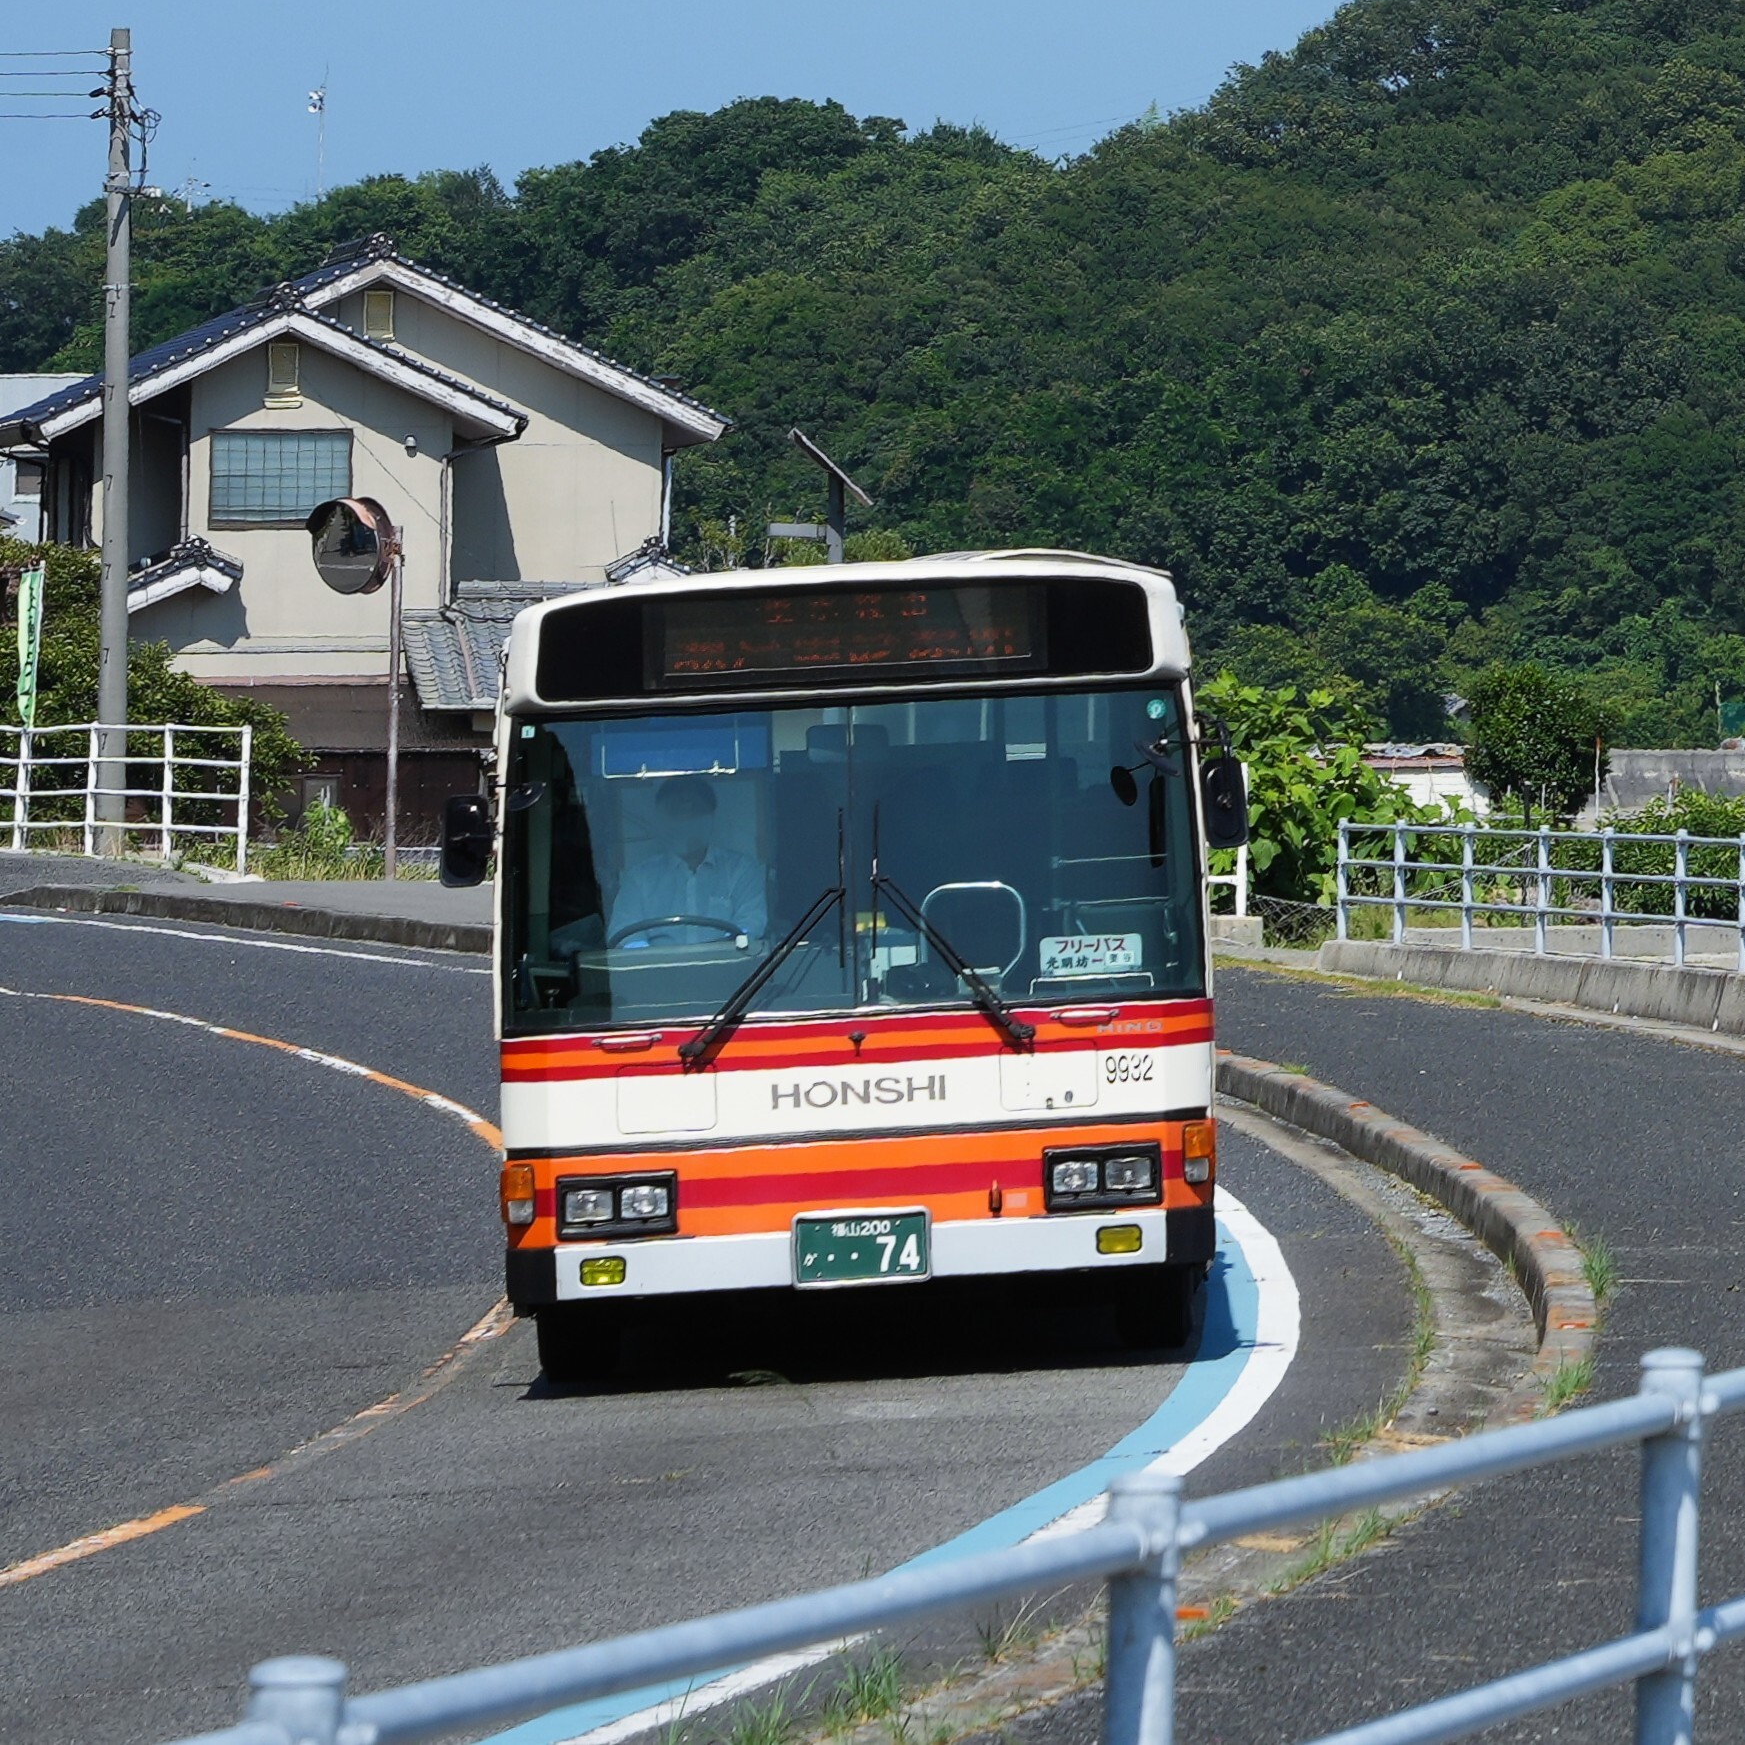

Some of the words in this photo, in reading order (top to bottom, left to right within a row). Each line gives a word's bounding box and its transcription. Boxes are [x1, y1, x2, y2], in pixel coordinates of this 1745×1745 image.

[1054, 937, 1127, 954] フリーバス
[1097, 1021, 1164, 1033] HINO
[1105, 1054, 1154, 1084] 9932
[771, 1074, 947, 1110] HONSHI
